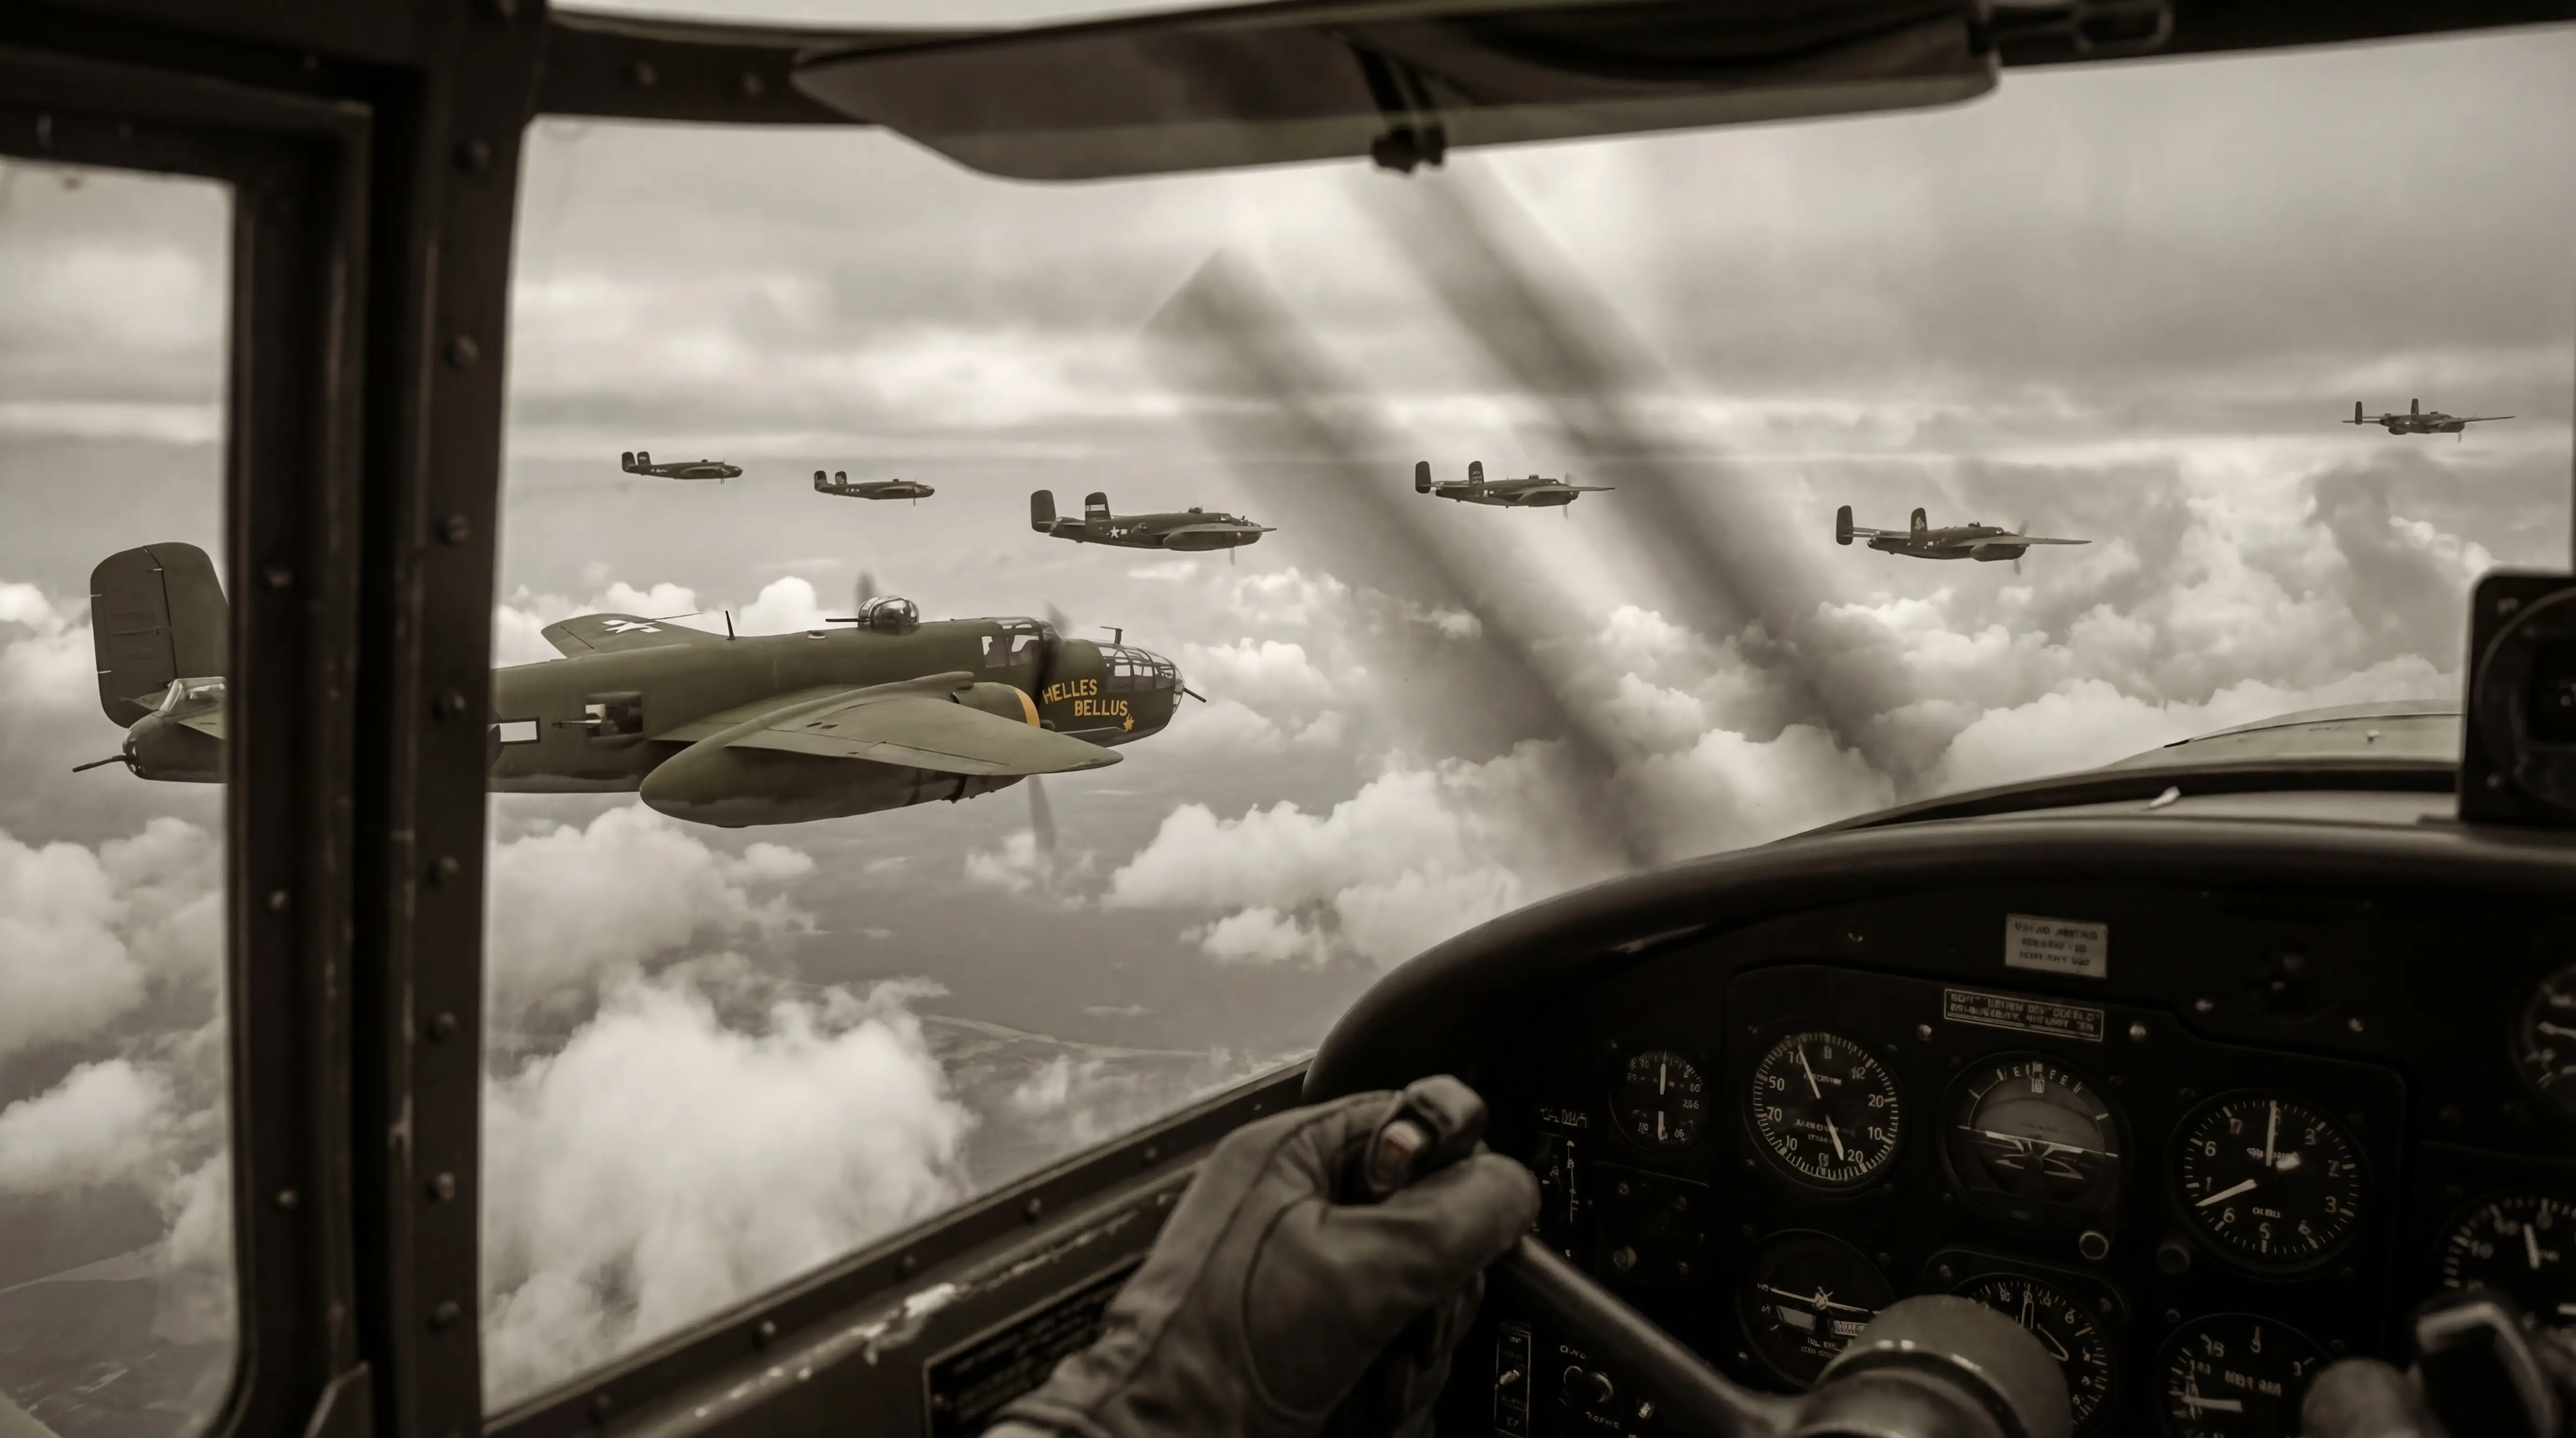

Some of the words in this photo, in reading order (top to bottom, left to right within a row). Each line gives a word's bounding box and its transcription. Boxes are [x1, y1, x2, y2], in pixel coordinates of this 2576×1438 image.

[1042, 679, 1098, 704] HELLES
[1075, 700, 1128, 717] BELLUS
[1769, 1076, 1785, 1091] 50
[1867, 1093, 1884, 1108] 20
[1766, 1106, 1783, 1122] 70
[1867, 1126, 1882, 1141] 10
[2304, 1128, 2316, 1145] 3
[1847, 1149, 1864, 1163] 20
[2204, 1141, 2217, 1157] 6
[2324, 1196, 2337, 1213] 3
[2223, 1207, 2236, 1223] 6
